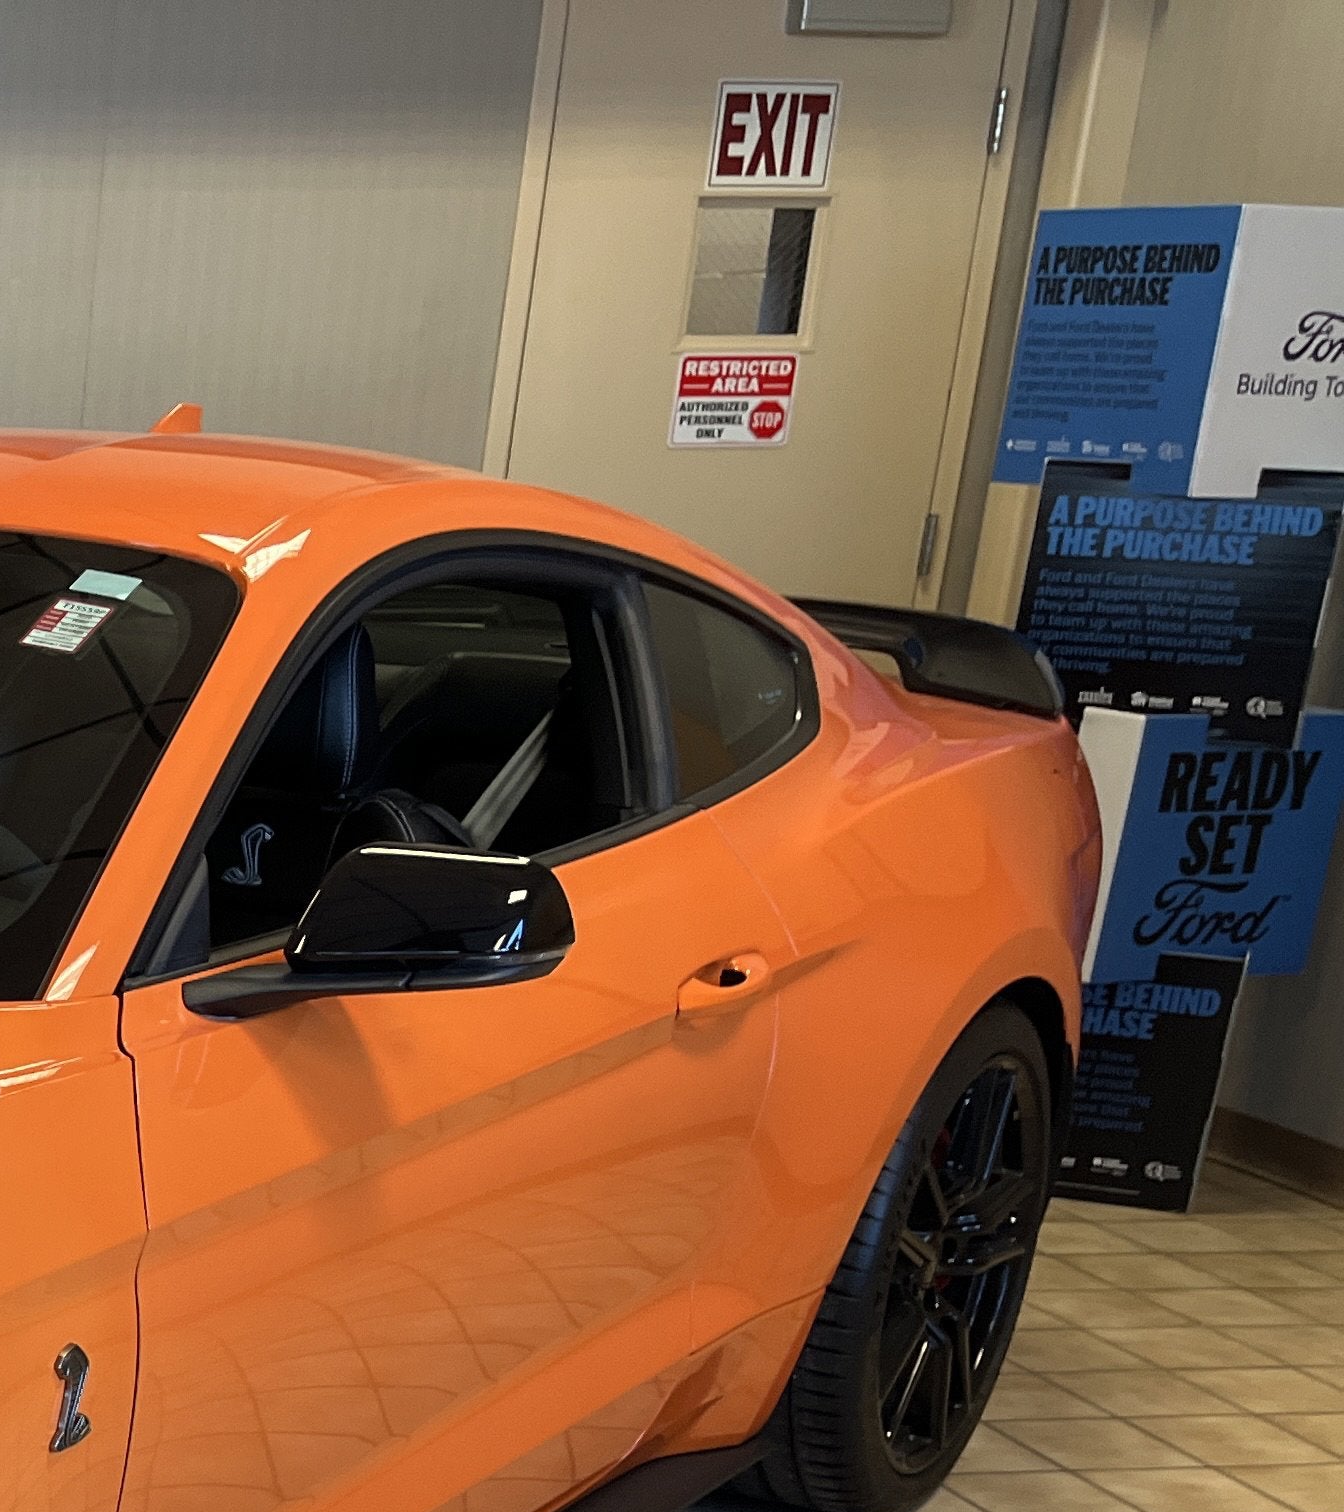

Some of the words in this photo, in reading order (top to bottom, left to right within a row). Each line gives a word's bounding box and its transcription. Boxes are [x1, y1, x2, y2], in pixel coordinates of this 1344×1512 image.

[716, 93, 831, 177] EXIT
[1037, 246, 1051, 274] A
[1053, 245, 1142, 274] PURPOSE
[1144, 244, 1221, 273] BEHIND
[1034, 277, 1068, 305] THE
[1069, 277, 1173, 306] PURCHASE
[684, 360, 792, 376] RESTRICTED
[711, 377, 760, 393] AREA
[1237, 372, 1318, 401] Building
[679, 401, 749, 412] AUTHORIZED
[679, 414, 742, 425] PERSONNEL
[752, 412, 782, 428] STOP
[696, 428, 724, 438] ONLY
[1049, 495, 1068, 526] A
[1075, 496, 1208, 530] PURPOSE
[1214, 503, 1323, 537] BEHIND
[1046, 526, 1101, 557] THE
[1103, 529, 1258, 565] PURCHASE
[1158, 751, 1323, 813] READY
[1179, 814, 1272, 876] SET
[1133, 878, 1292, 947] Ford
[1116, 983, 1222, 1017] BEHIND
